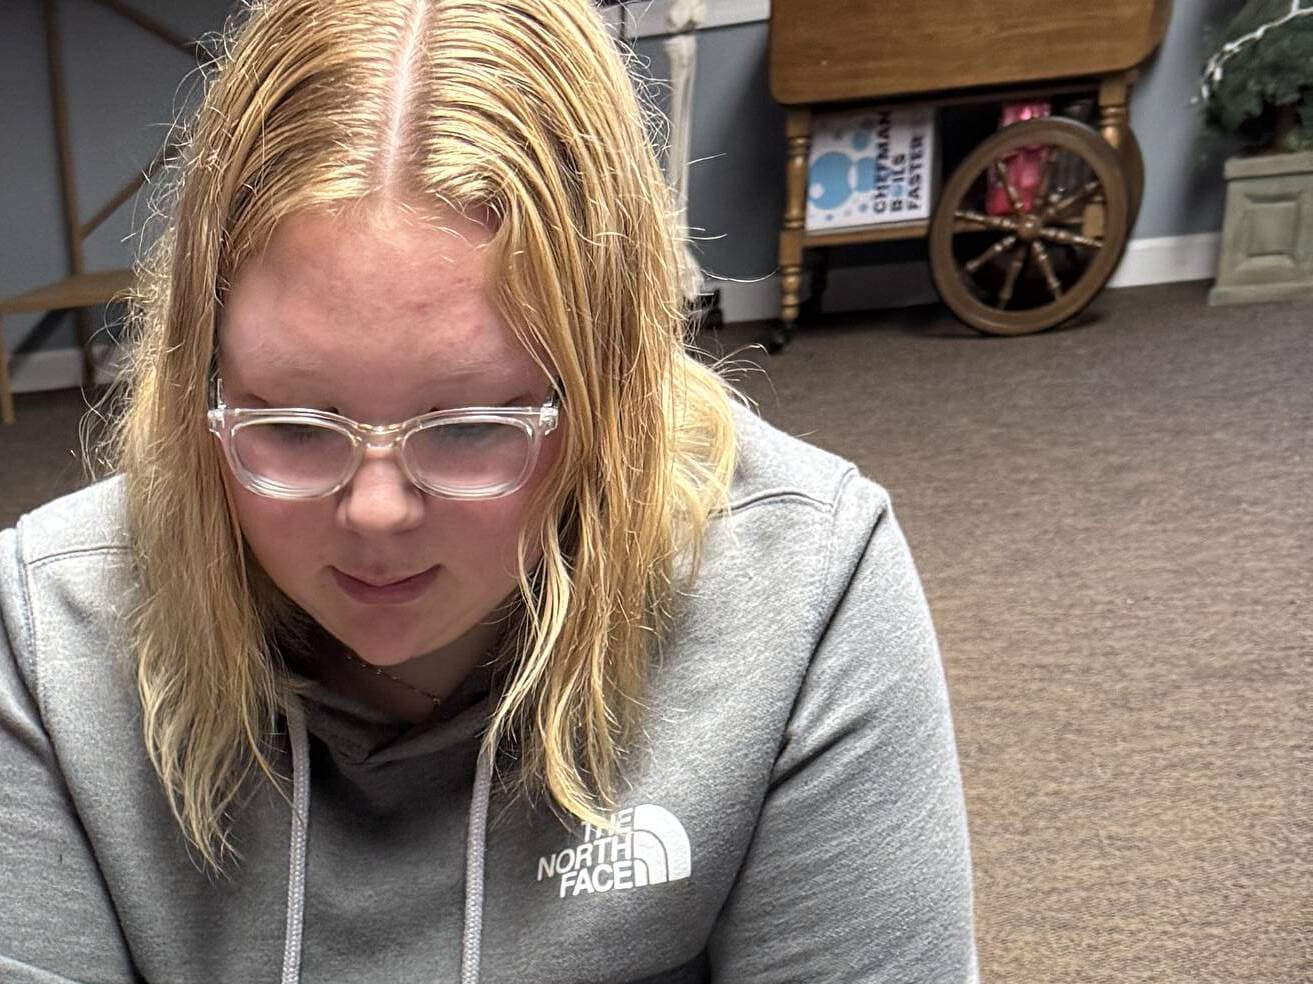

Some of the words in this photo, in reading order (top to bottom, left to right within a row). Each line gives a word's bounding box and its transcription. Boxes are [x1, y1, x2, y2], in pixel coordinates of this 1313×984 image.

[874, 112, 891, 212] CHEFMAN
[908, 136, 923, 210] FASTER
[537, 834, 632, 881] NORTH
[559, 861, 633, 898] FACE
